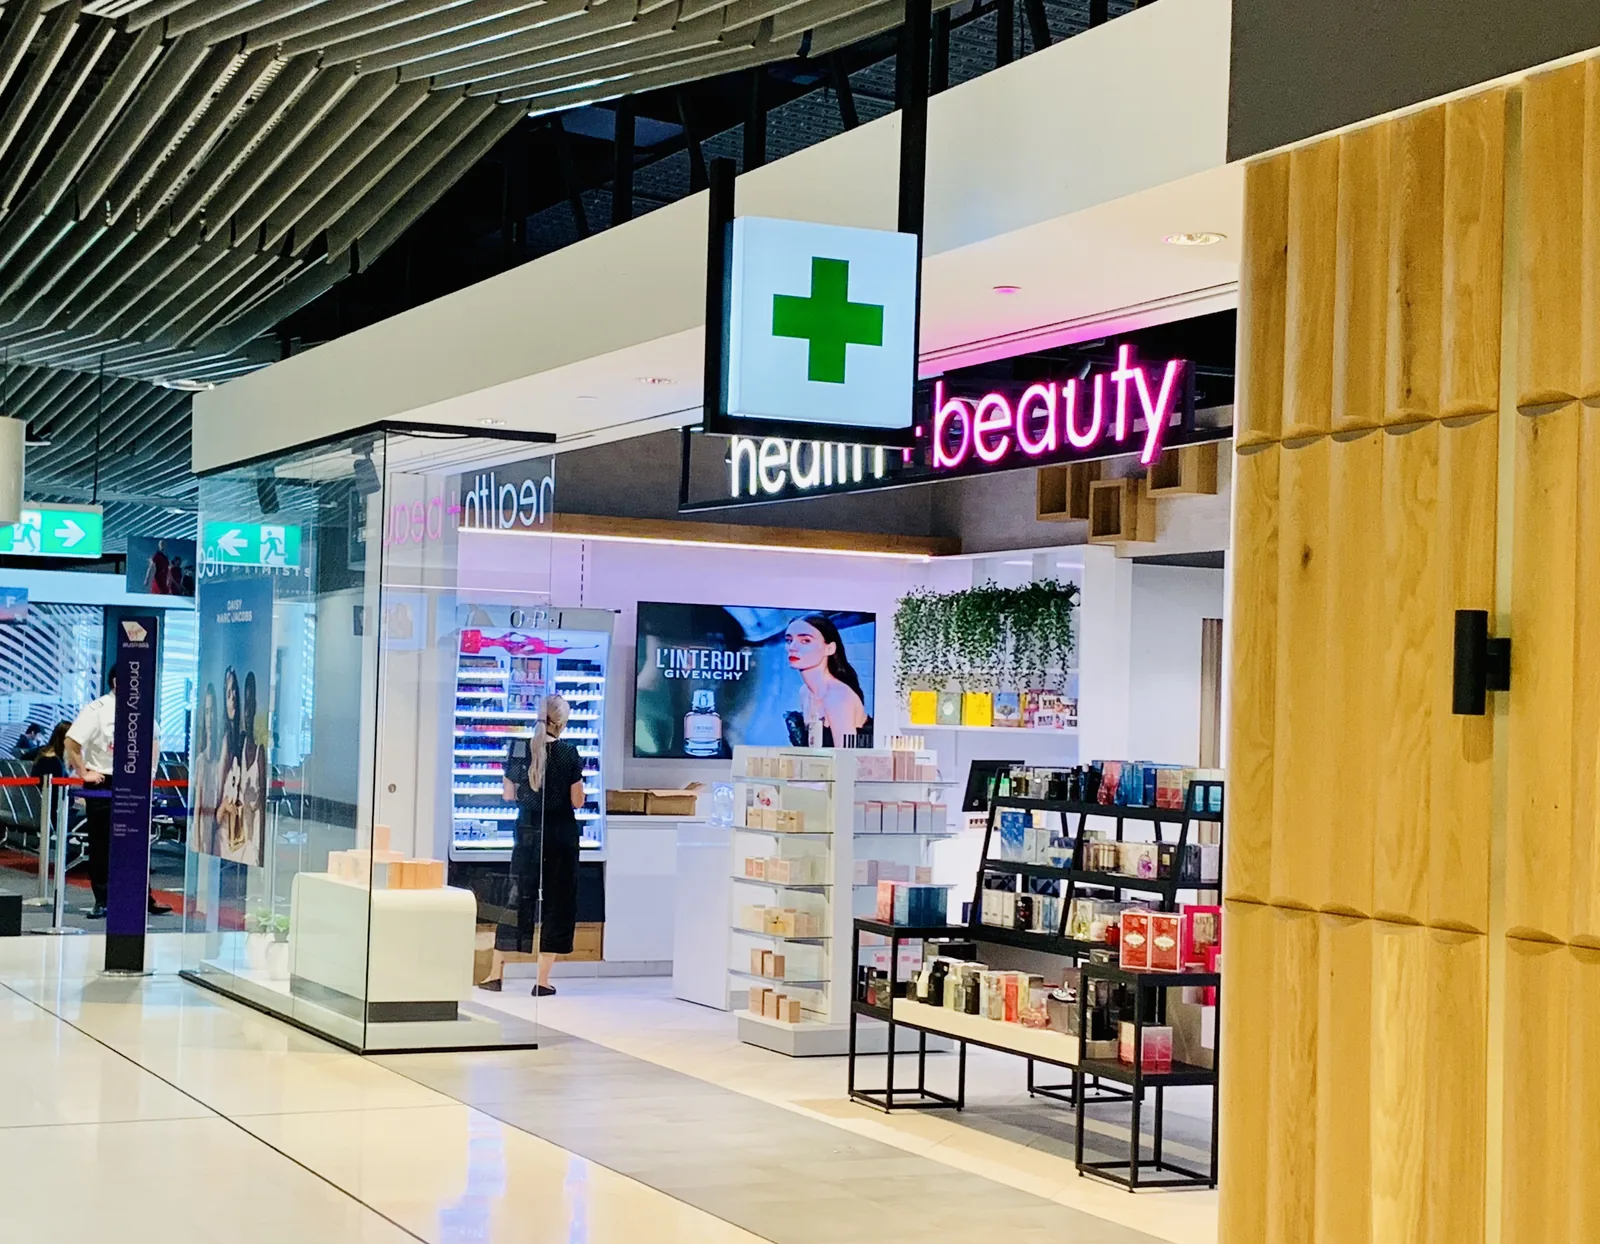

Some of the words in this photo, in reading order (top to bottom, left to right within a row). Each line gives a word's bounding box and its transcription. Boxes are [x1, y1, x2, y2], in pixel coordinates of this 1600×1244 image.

[932, 344, 1176, 467] beauty
[127, 661, 142, 710] priority
[664, 669, 743, 680] GIVENCHY
[124, 713, 141, 774] boarding
